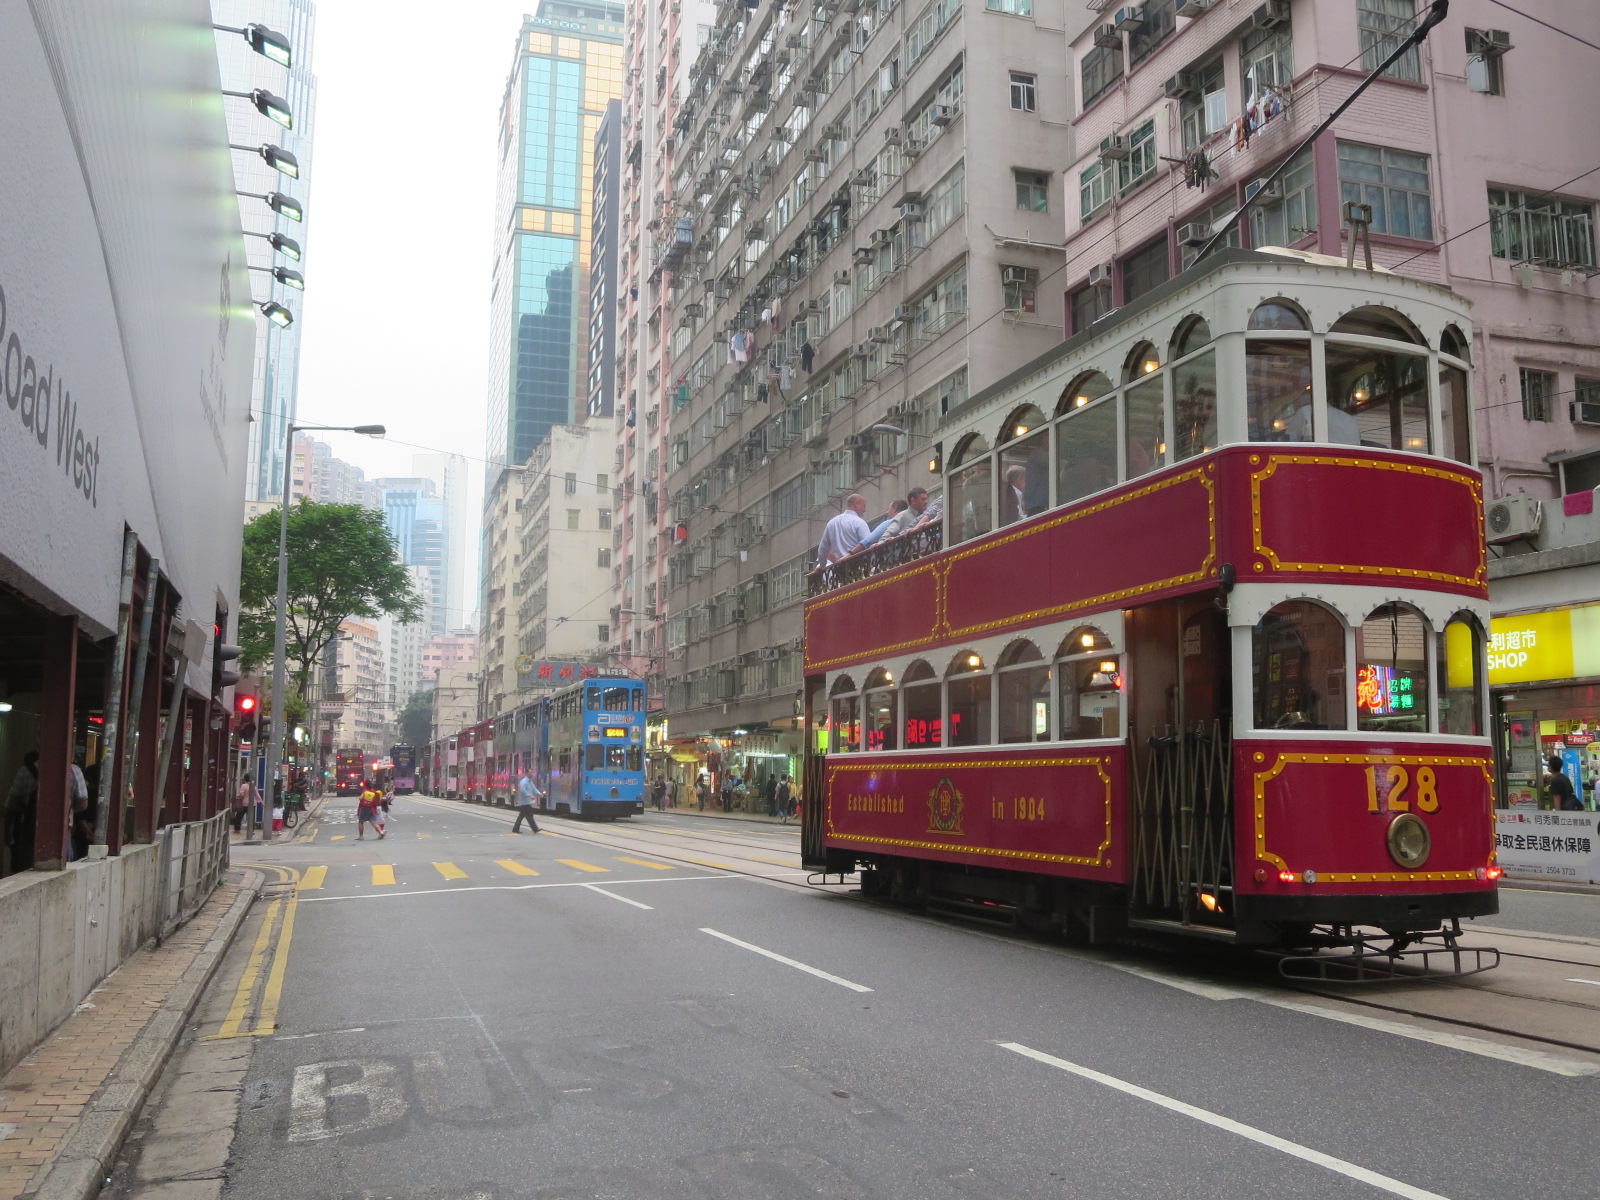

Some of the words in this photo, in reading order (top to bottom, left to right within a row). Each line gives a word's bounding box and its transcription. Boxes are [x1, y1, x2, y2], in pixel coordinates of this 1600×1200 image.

[57, 378, 100, 509] West
[1487, 629, 1536, 652] 利超市
[847, 793, 904, 815] Established
[992, 797, 1004, 820] in
[1013, 797, 1046, 821] 1904
[1364, 764, 1439, 814] 128
